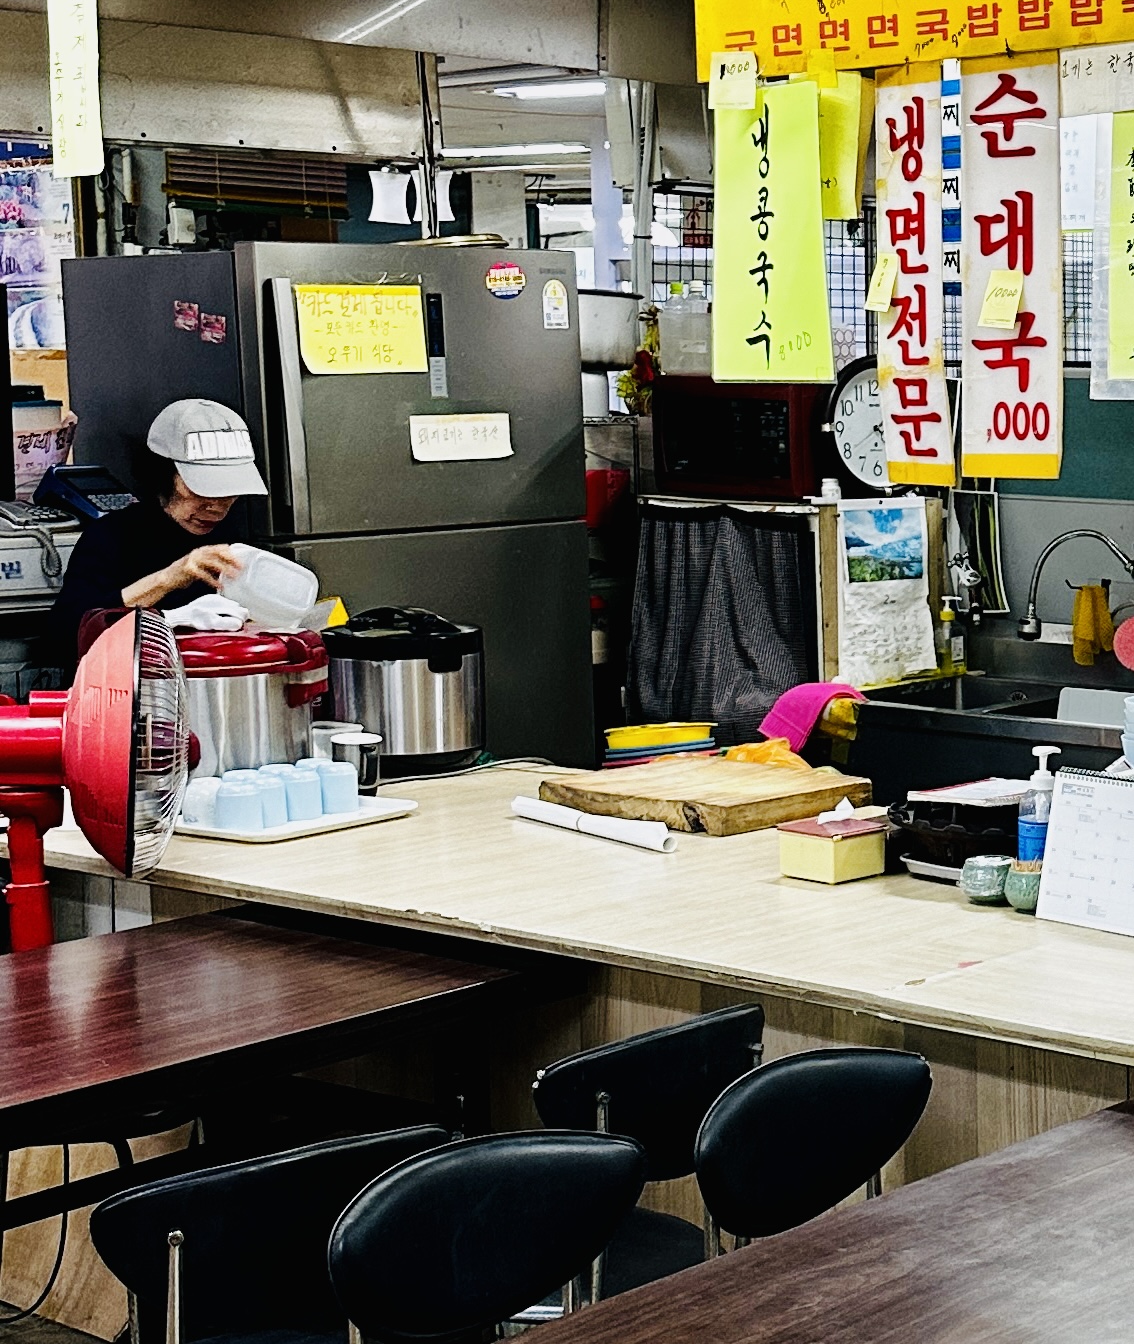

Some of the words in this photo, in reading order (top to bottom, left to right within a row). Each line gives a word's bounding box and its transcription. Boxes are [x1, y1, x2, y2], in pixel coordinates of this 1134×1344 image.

[970, 73, 1048, 393] 순대국
[885, 96, 942, 458] 냉면전문
[853, 384, 864, 403] 11
[868, 379, 880, 397] 12
[840, 399, 855, 417] 10
[835, 420, 845, 439] 9
[843, 442, 853, 460] 8
[858, 455, 867, 473] 7
[873, 459, 883, 477] 6
